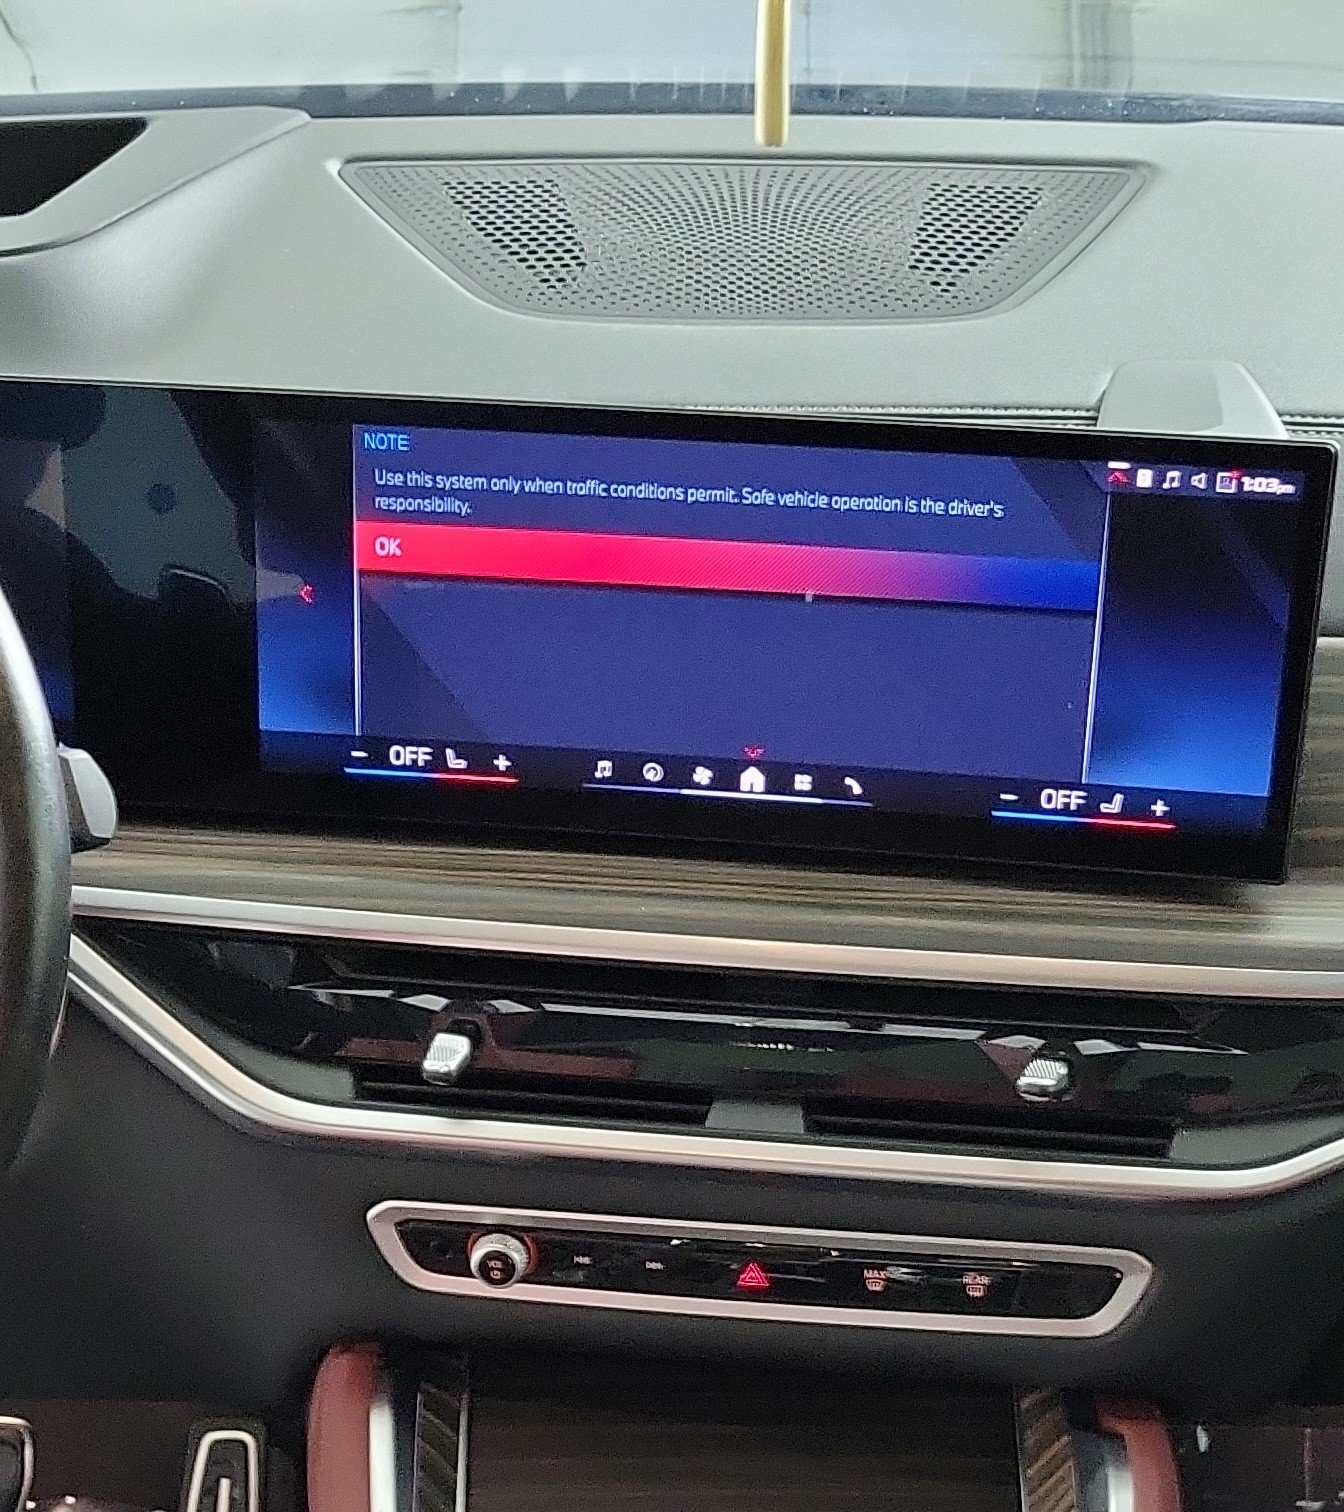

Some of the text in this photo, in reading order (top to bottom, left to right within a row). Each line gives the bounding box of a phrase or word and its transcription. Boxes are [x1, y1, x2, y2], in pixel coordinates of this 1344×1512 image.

[364, 433, 409, 450] NOTE
[374, 468, 1004, 518] Use this system only when traffic conditions permit. Safe vehicle operation is the driver's
[374, 496, 472, 517] responsibility.
[374, 536, 402, 556] OK
[389, 745, 433, 766] OFF
[1040, 788, 1088, 810] OFF
